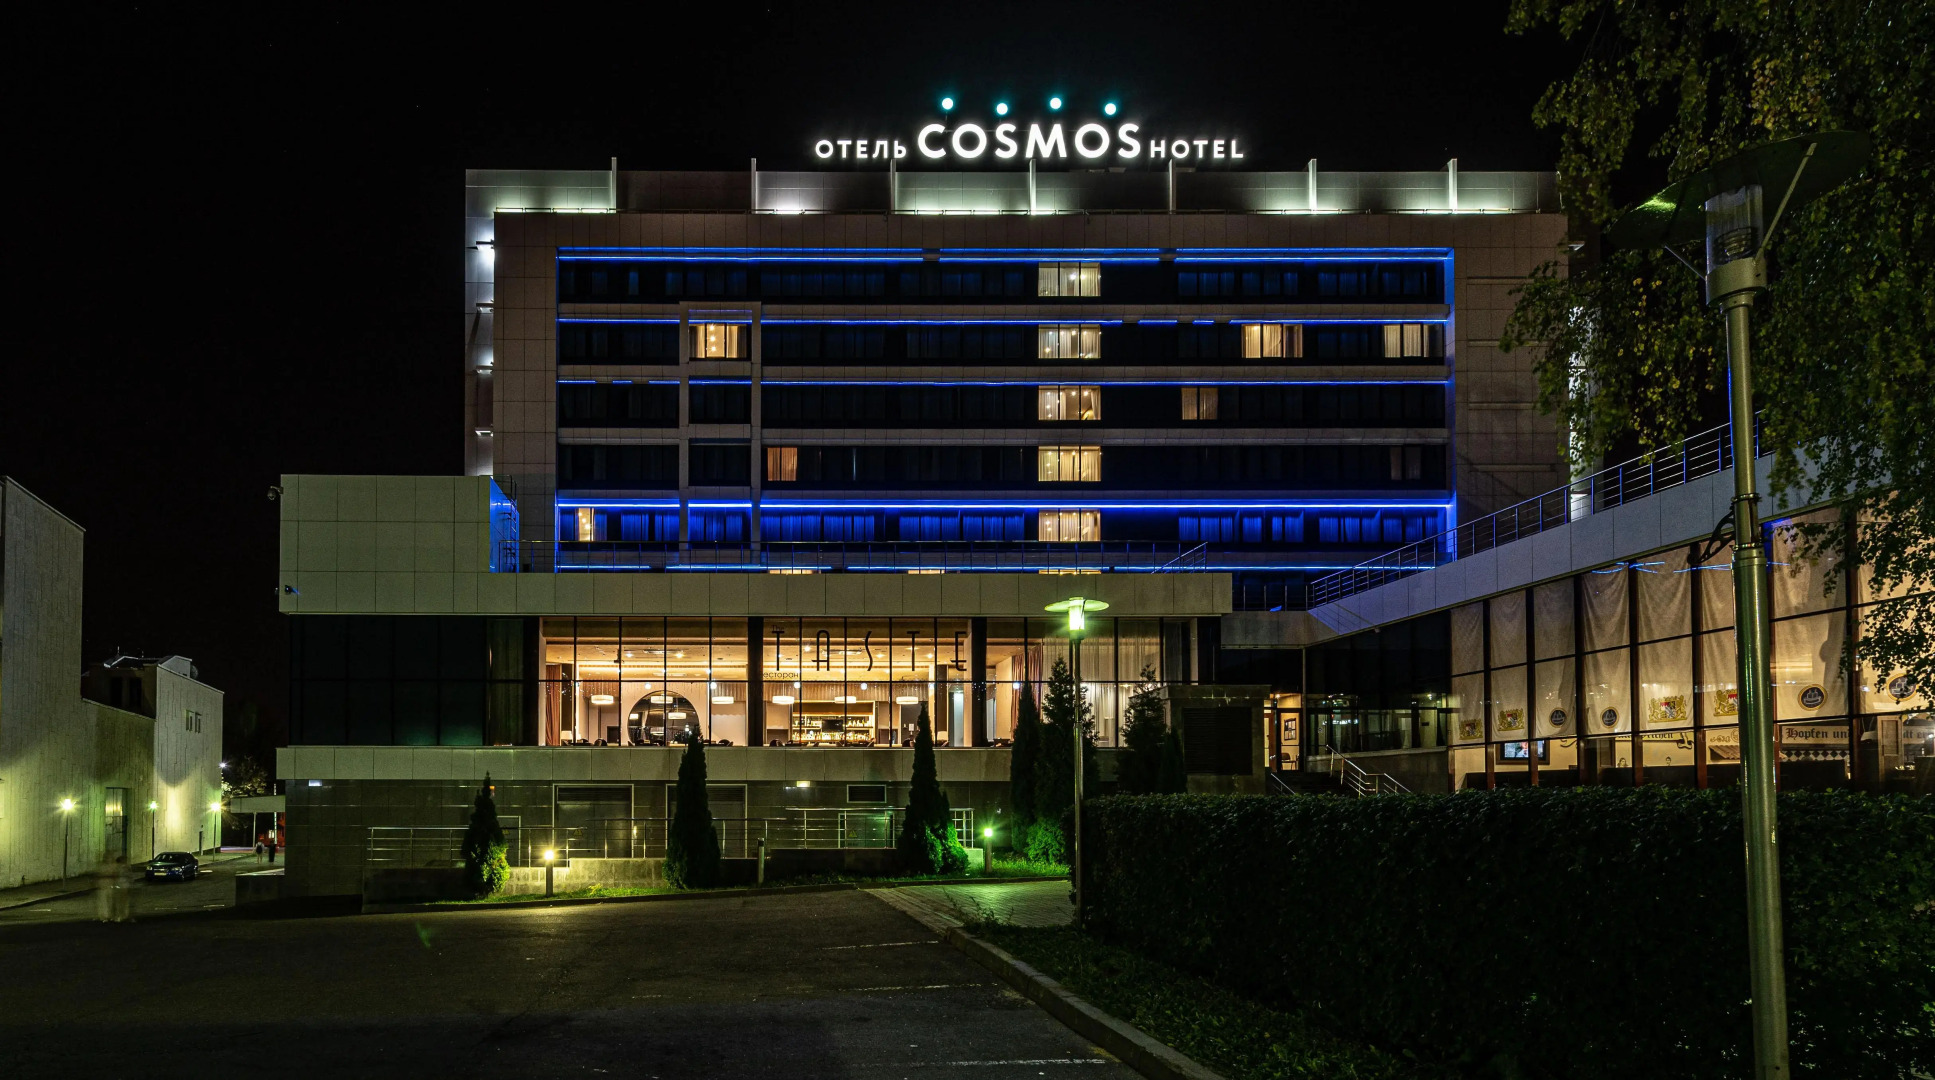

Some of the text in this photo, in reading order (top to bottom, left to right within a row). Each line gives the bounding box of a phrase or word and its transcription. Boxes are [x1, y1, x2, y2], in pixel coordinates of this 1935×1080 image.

[815, 123, 1244, 159] ОТЕЛЬ COSMOS HOTEL
[771, 630, 967, 672] TASTE
[763, 672, 799, 680] есторан
[1786, 728, 1850, 740] Hopfen un
